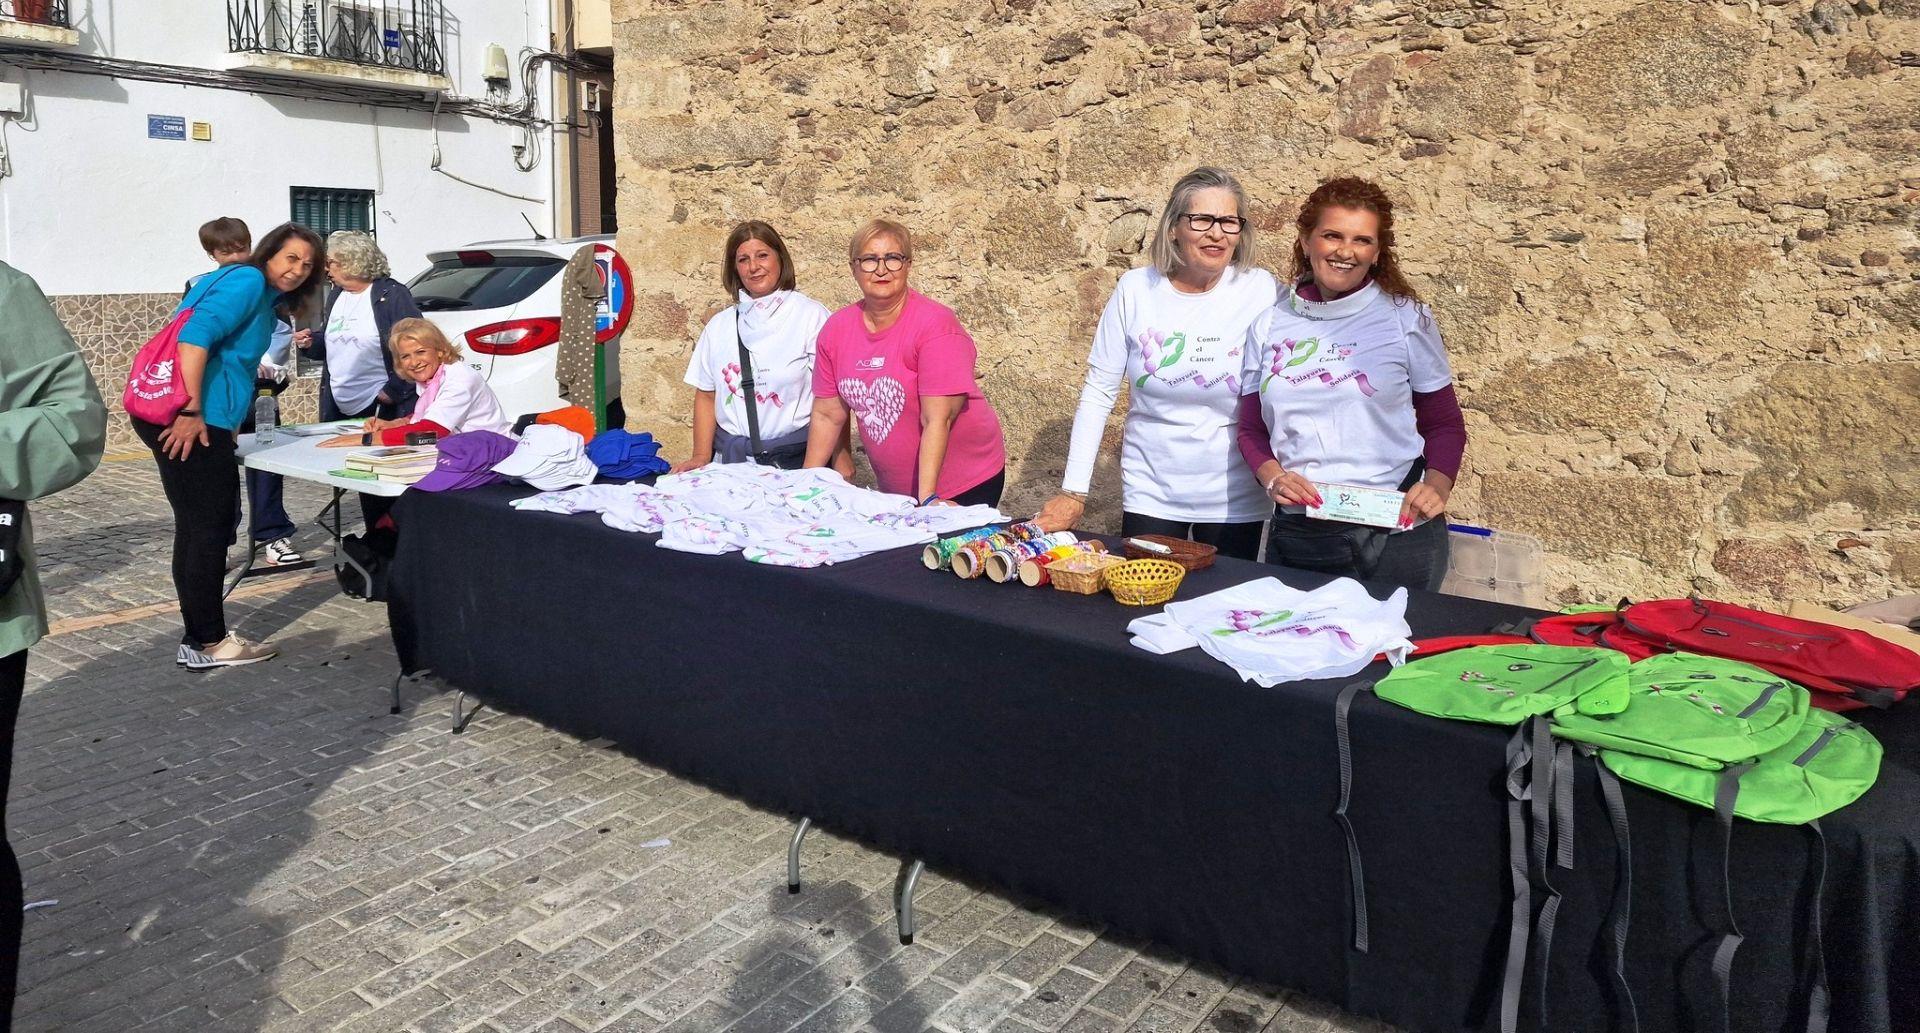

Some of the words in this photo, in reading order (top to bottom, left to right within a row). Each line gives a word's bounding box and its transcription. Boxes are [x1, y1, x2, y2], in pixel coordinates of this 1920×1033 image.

[162, 124, 184, 132] CINSA
[1290, 367, 1326, 385] Talayuela
[1329, 369, 1361, 388] Solidaria
